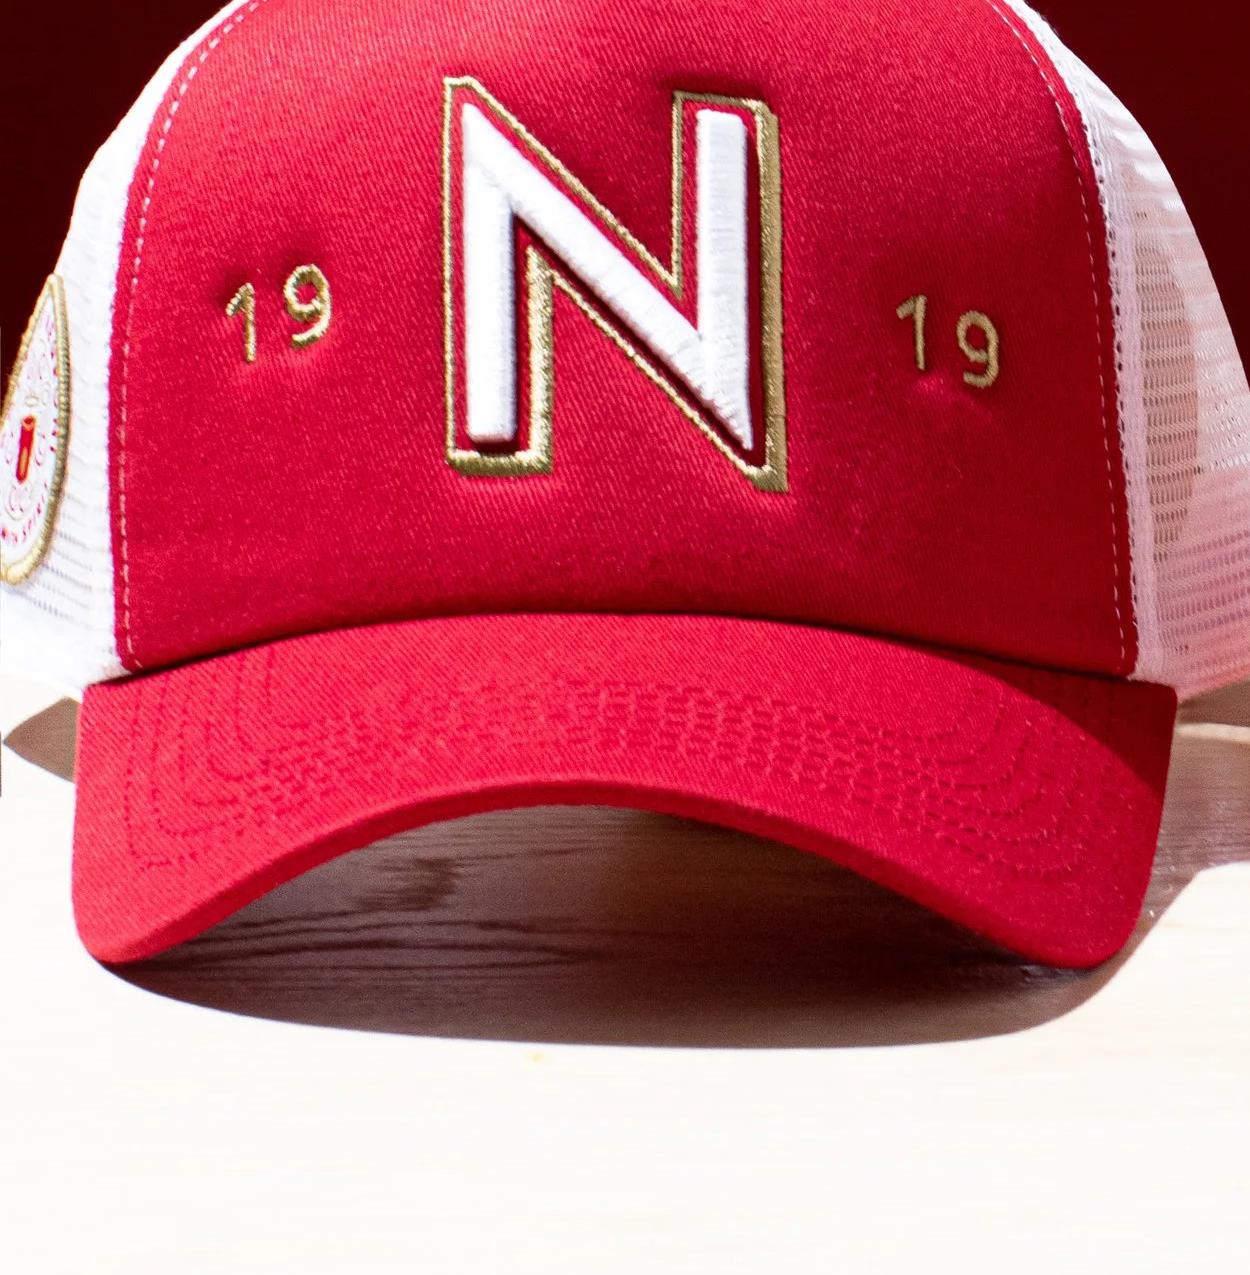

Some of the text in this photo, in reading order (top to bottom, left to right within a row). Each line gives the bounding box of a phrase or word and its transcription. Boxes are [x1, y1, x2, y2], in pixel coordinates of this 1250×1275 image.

[225, 74, 999, 492] 19 N 19
